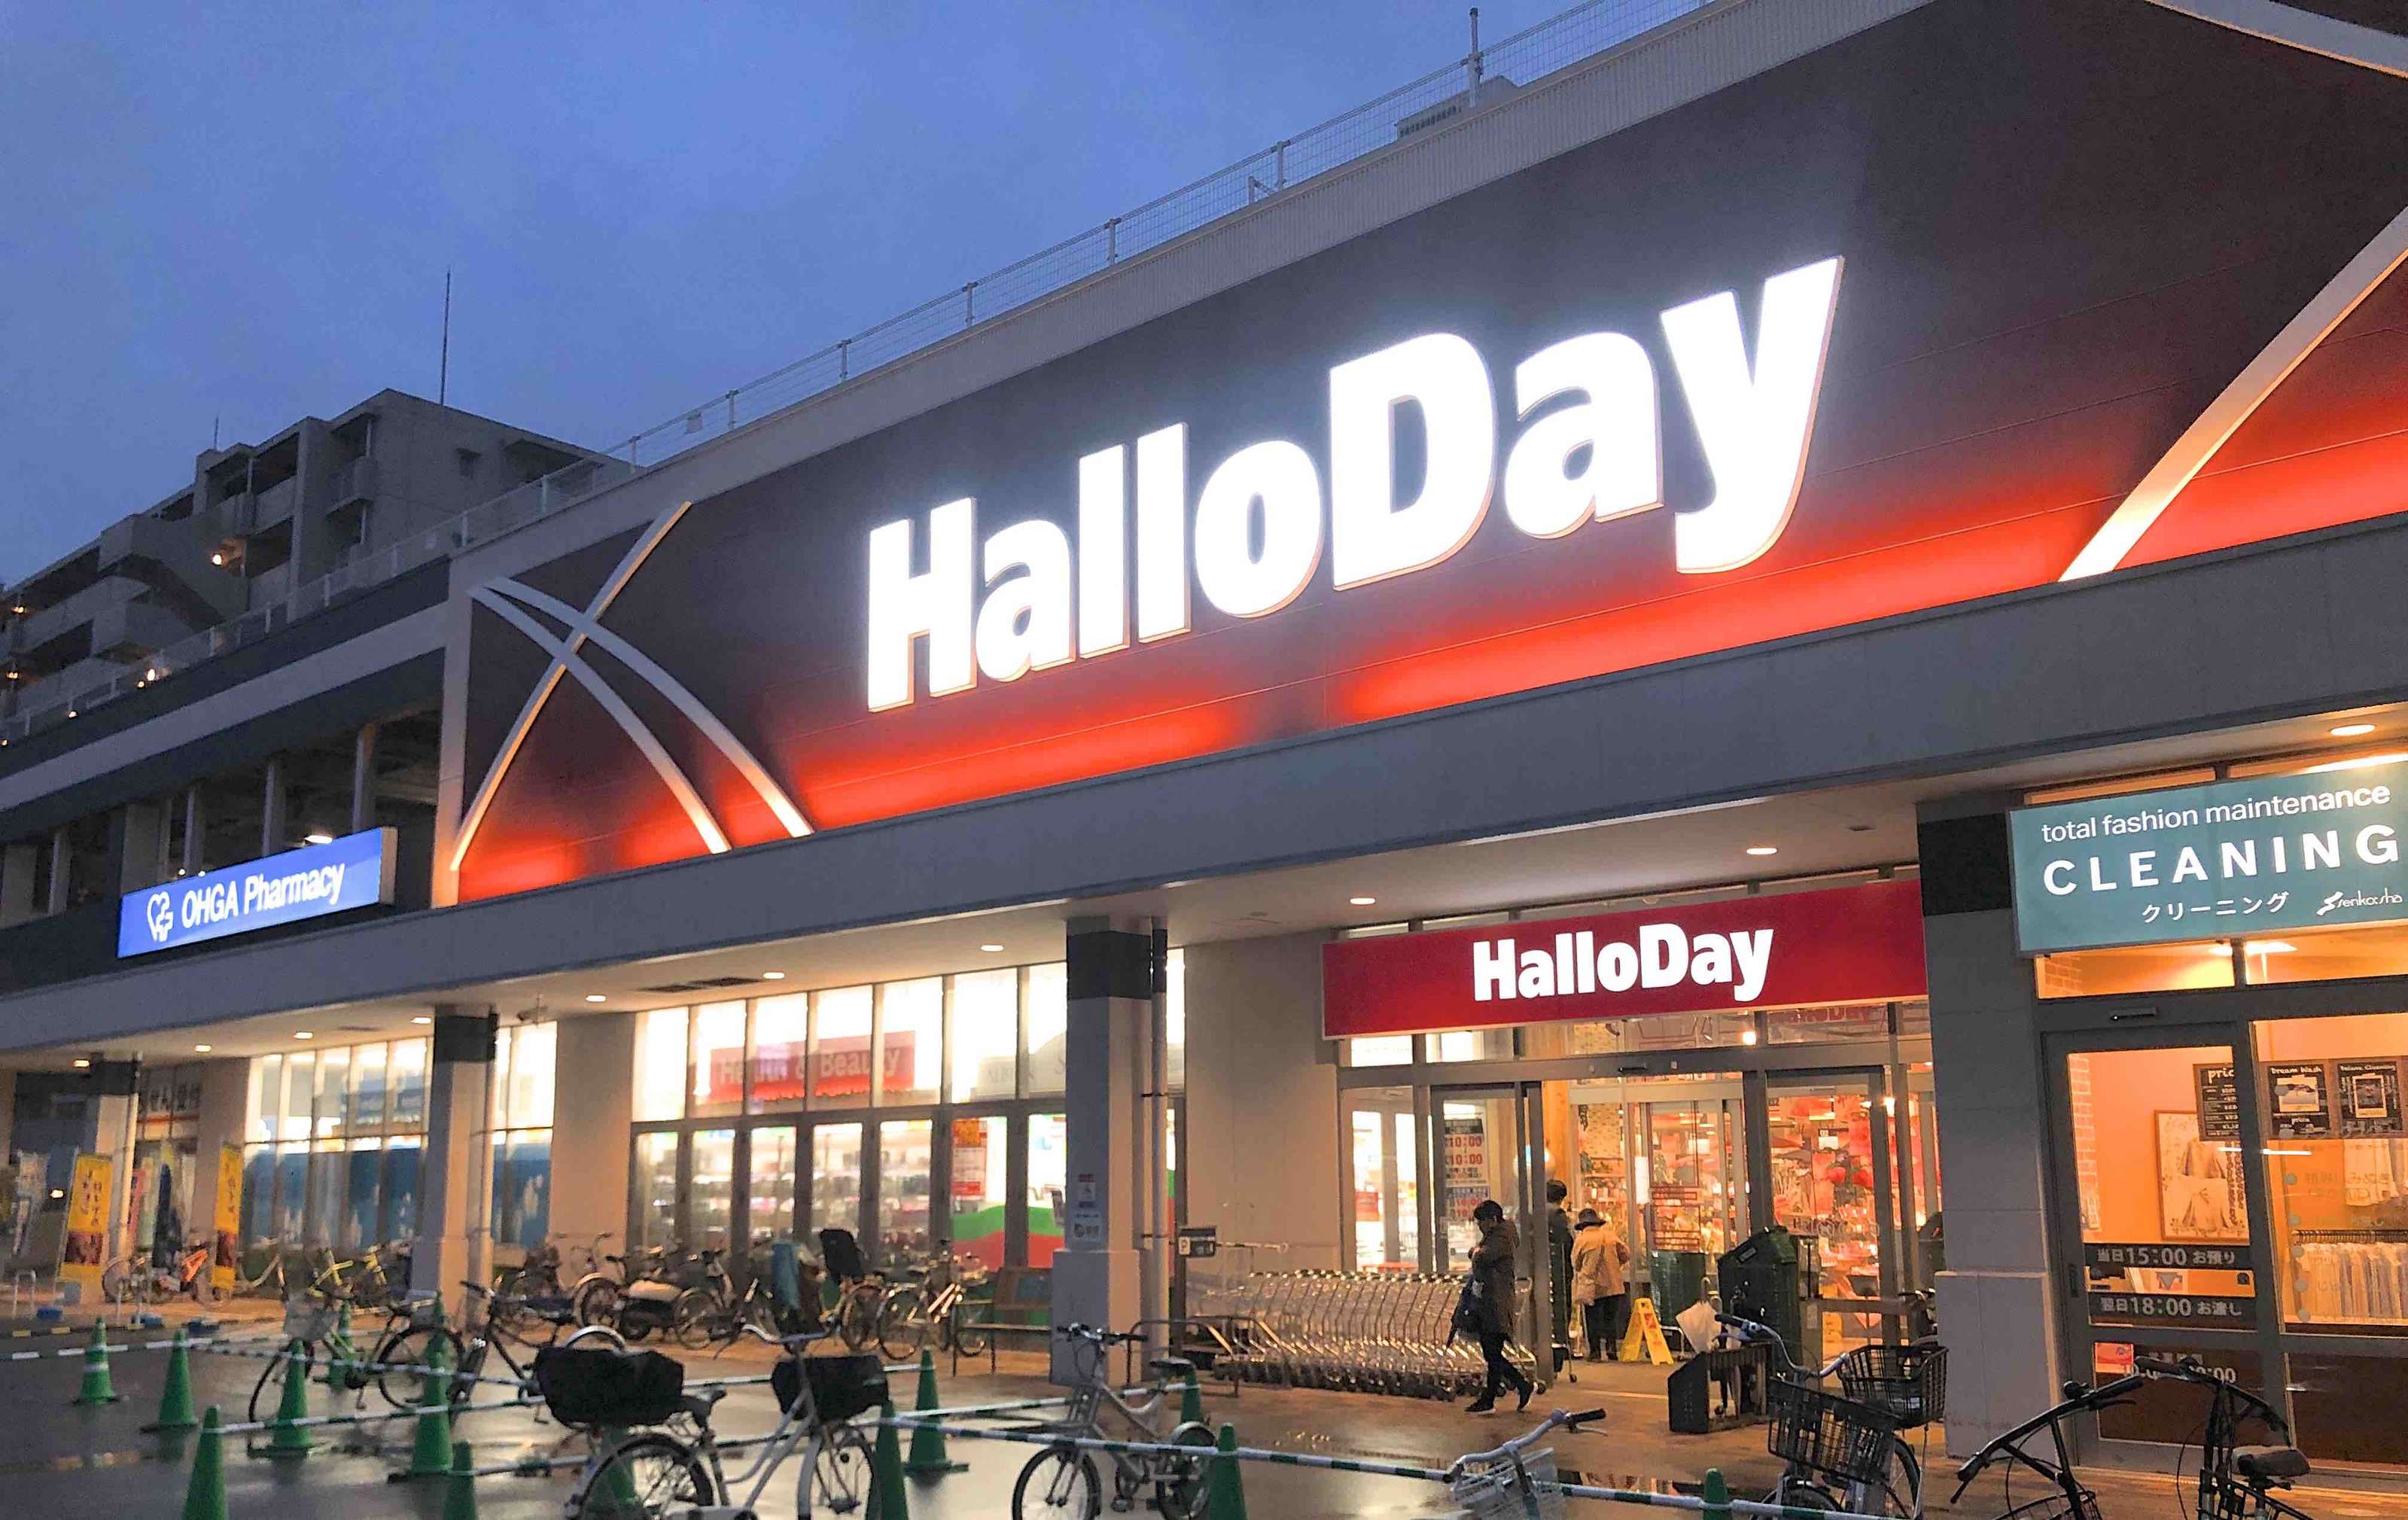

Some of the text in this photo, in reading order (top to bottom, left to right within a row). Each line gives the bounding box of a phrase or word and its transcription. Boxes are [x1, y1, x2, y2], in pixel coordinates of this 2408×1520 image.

[867, 255, 1844, 712] HalloDay
[2042, 784, 2391, 843] total fashion maintenance
[2043, 824, 2400, 896] CLEANING
[181, 863, 346, 928] OHGA Pharmacy
[2142, 891, 2290, 923] クリーニング
[1473, 923, 1774, 1002] HalloDay
[2208, 1067, 2234, 1084] pric
